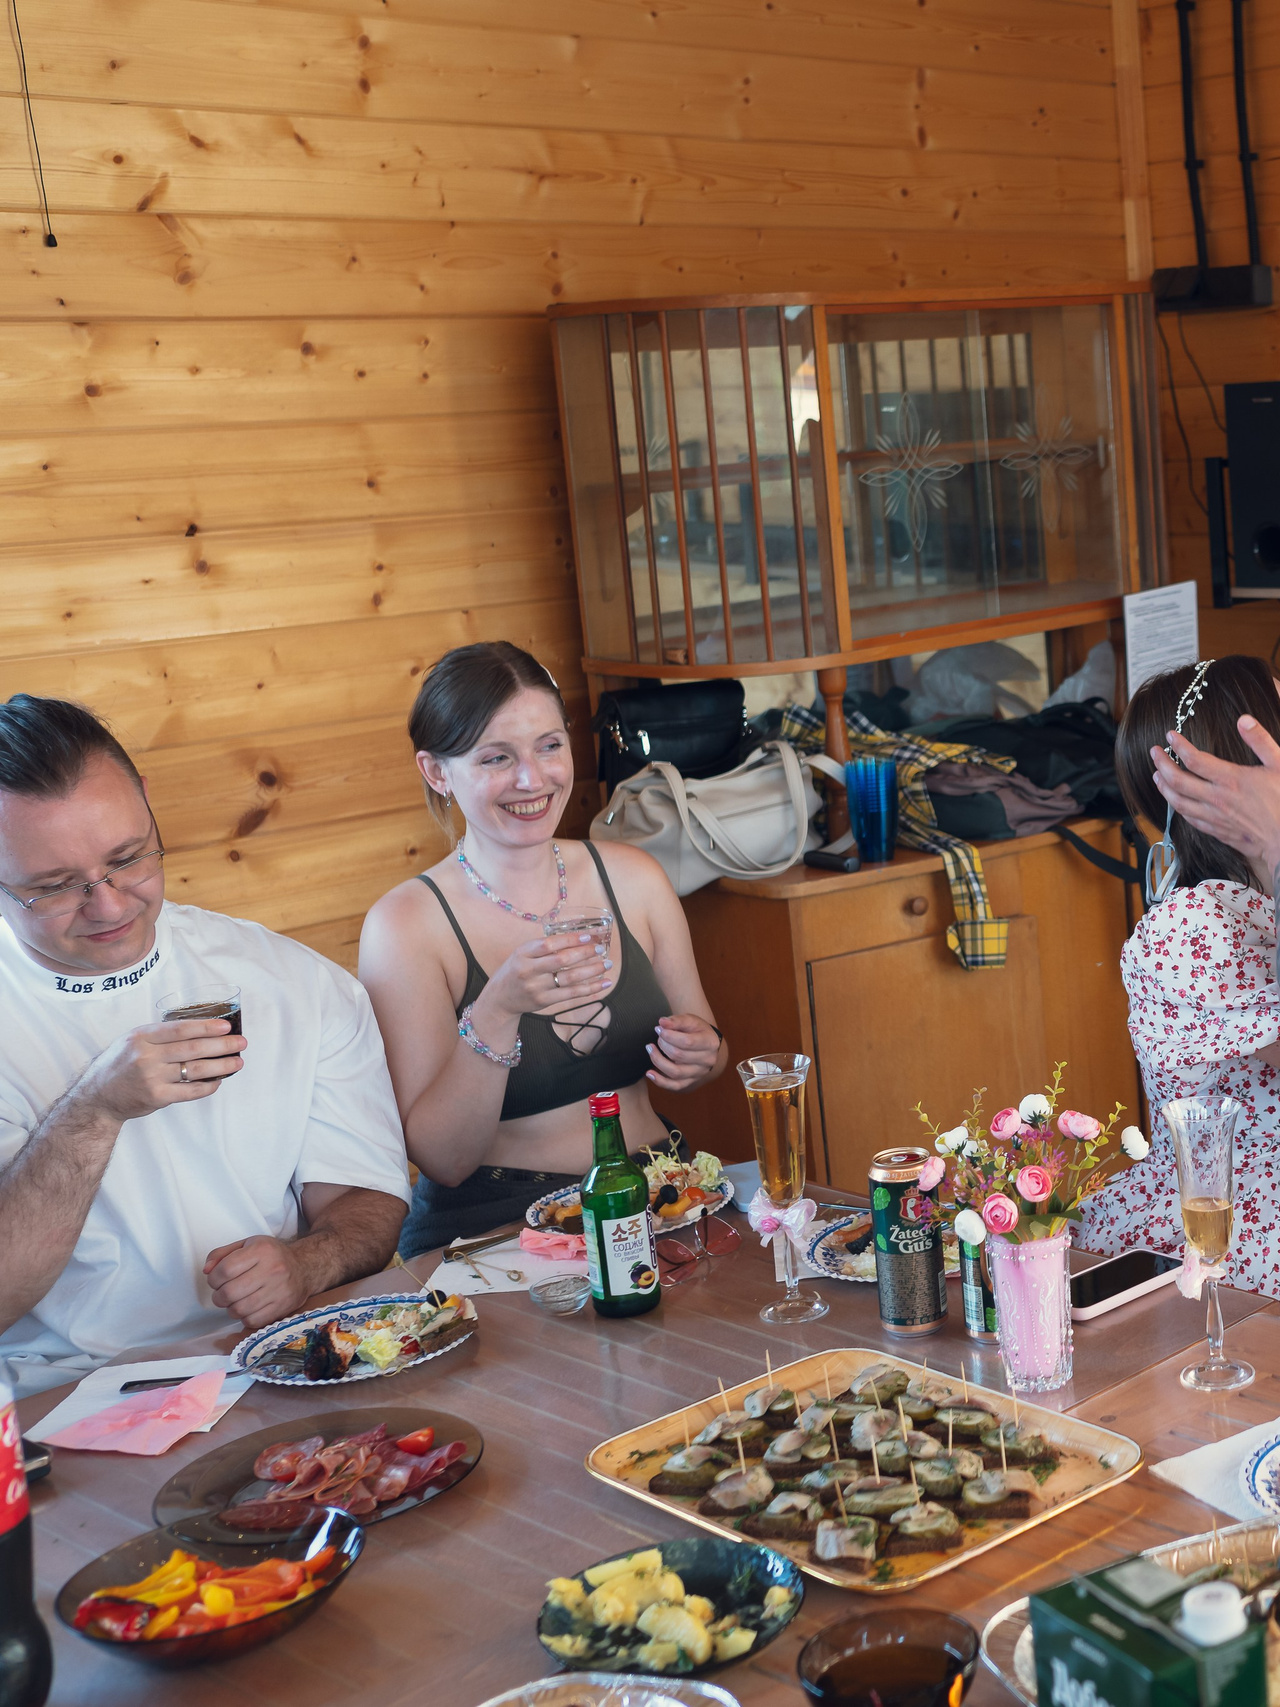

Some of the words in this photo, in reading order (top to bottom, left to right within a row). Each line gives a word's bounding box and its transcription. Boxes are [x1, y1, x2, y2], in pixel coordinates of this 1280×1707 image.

[54, 976, 95, 993] Los
[101, 947, 160, 991] Angeles
[611, 1217, 642, 1243] 소주
[613, 1237, 644, 1252] СОДЖУ
